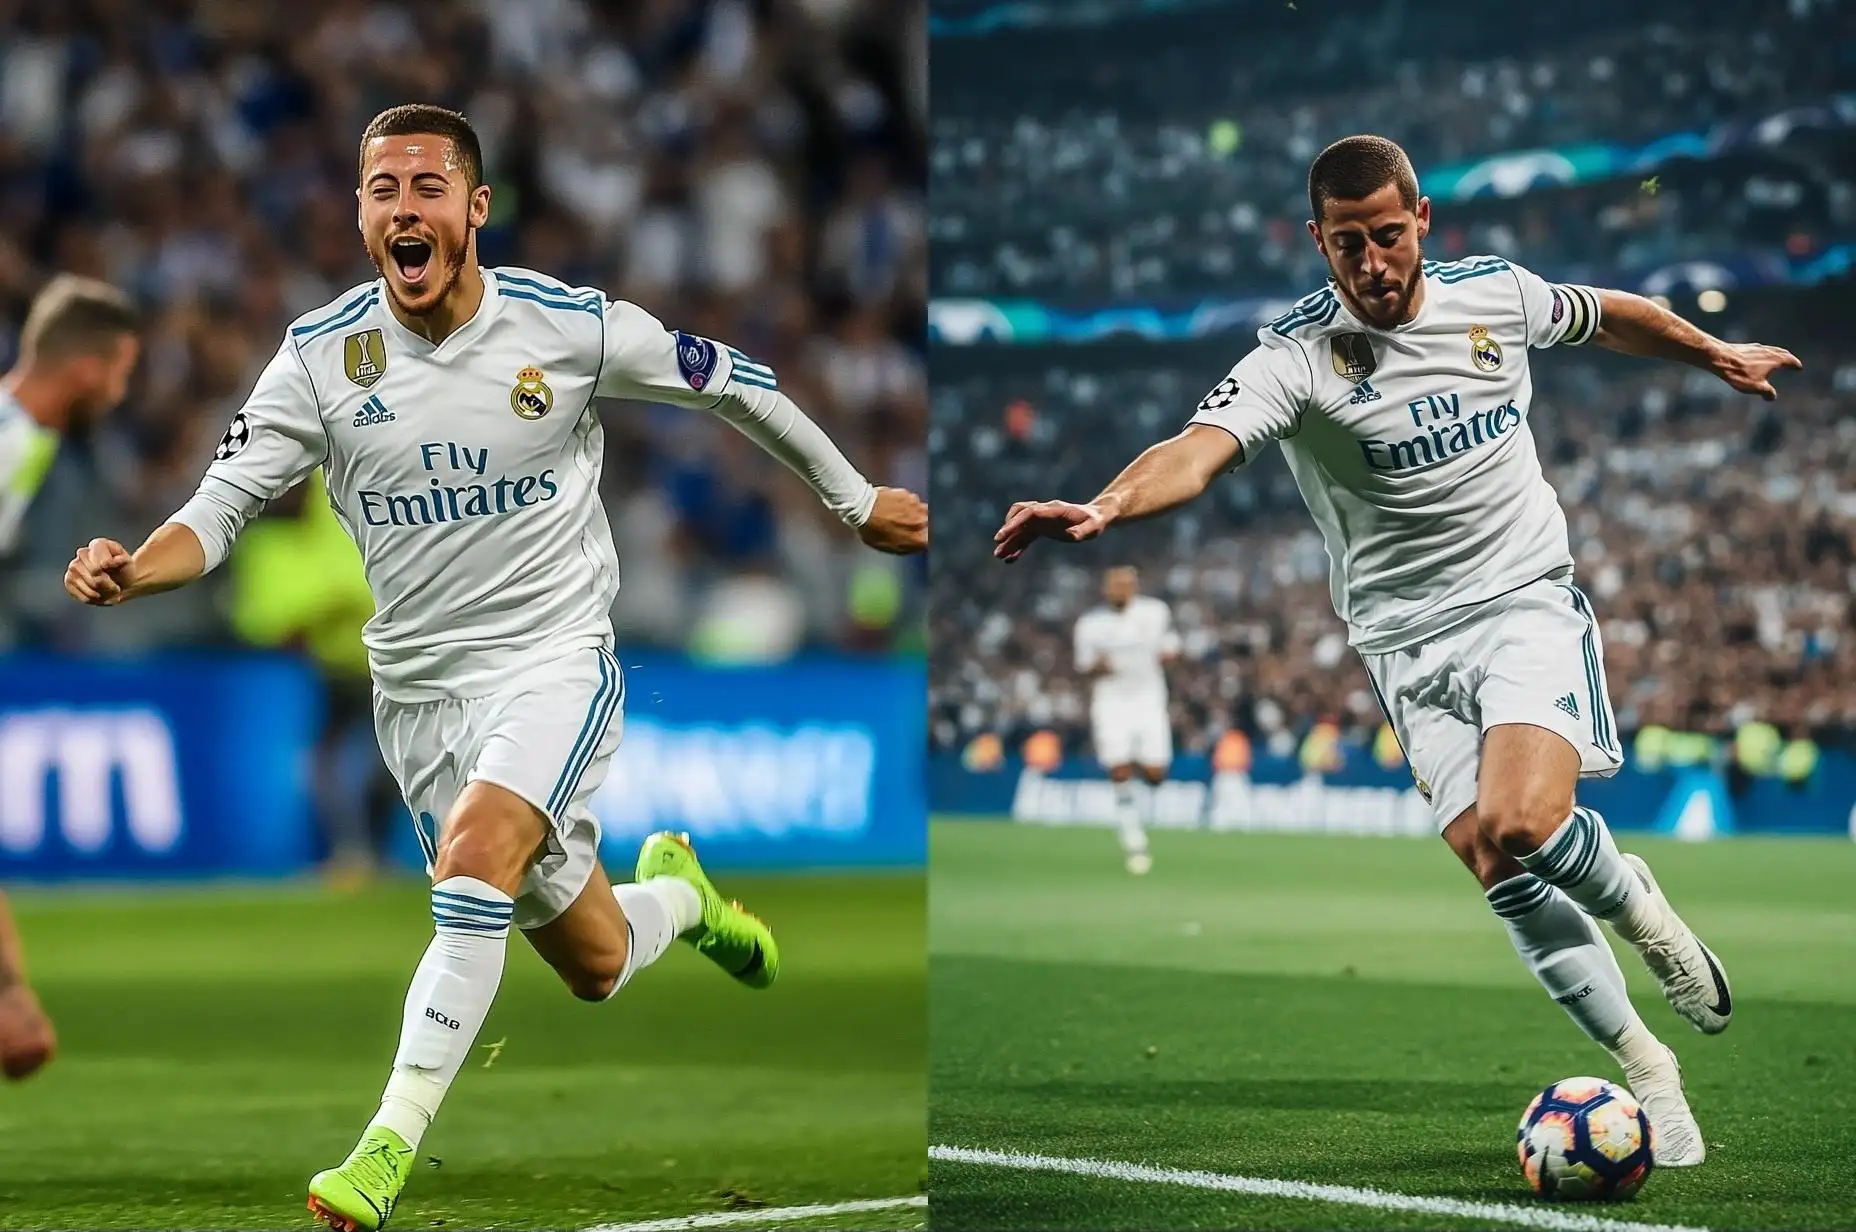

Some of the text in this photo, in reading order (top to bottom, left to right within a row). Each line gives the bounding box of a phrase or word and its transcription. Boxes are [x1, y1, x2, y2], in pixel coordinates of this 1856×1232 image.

[1408, 393, 1459, 427] Fly
[420, 442, 488, 475] Fly
[357, 468, 558, 527] Emirates
